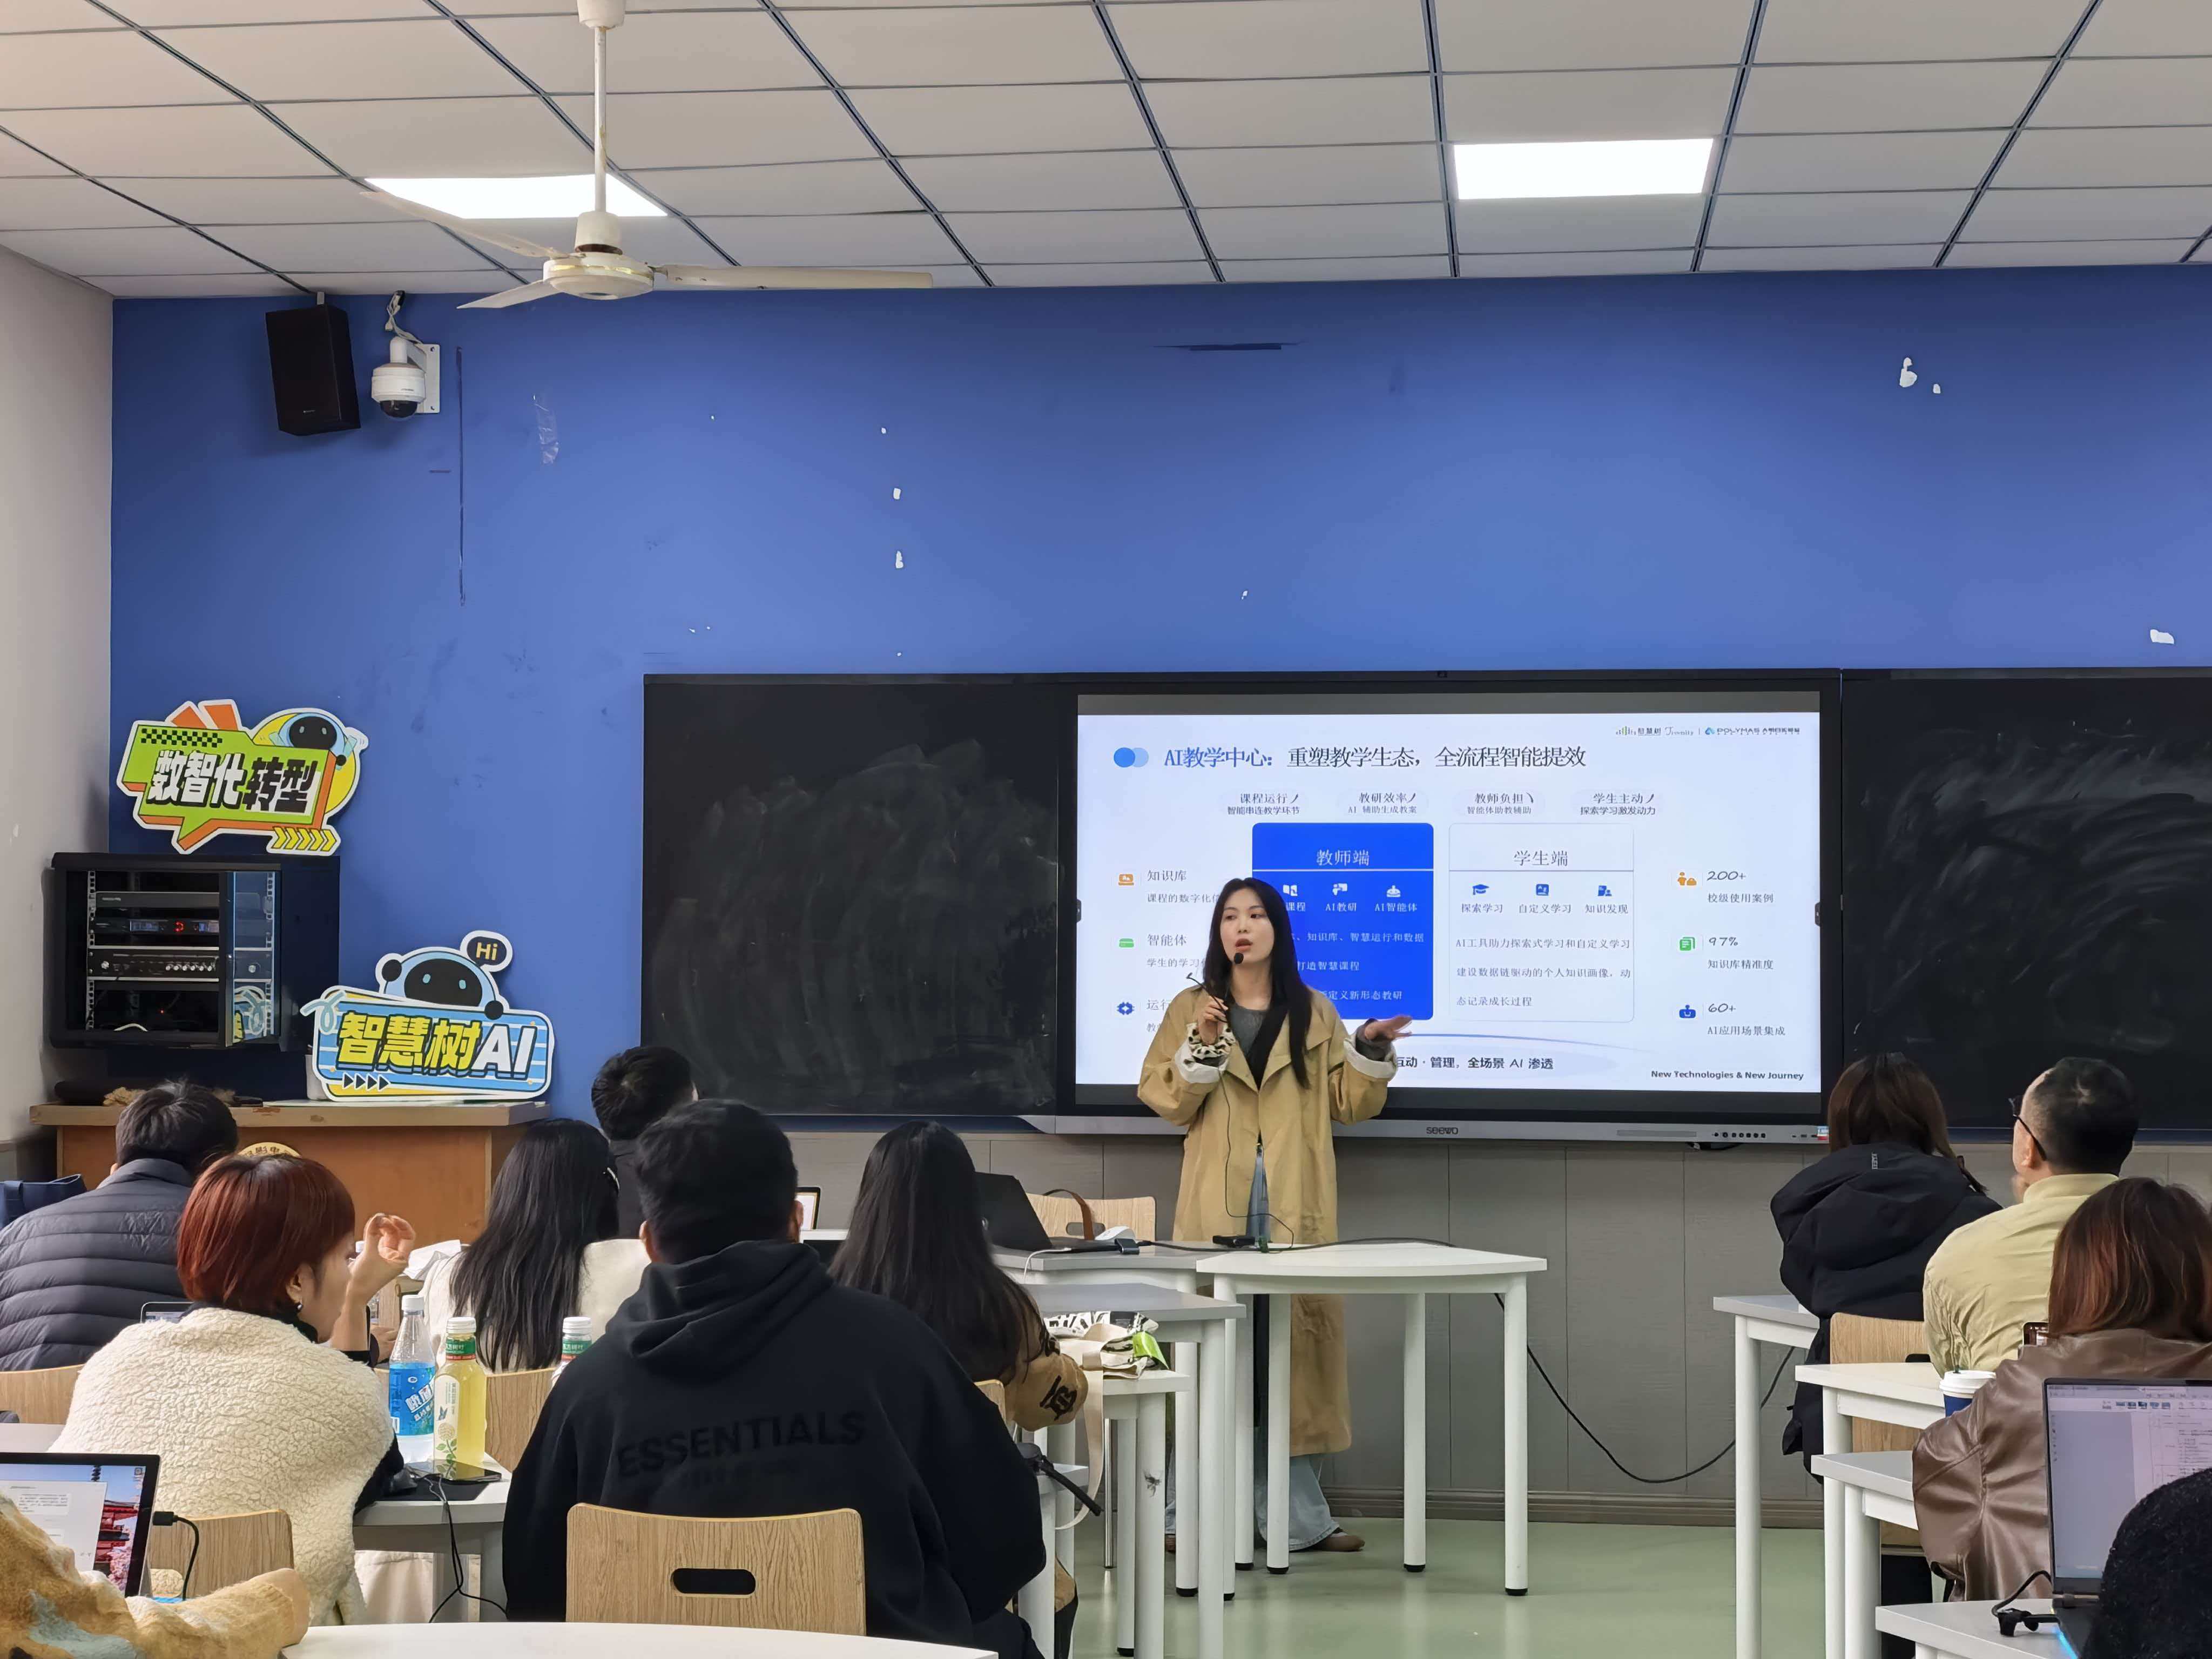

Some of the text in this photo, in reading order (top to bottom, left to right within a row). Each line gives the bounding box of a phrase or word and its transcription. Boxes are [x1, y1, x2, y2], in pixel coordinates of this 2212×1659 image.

[1164, 746, 1586, 768] AI教学中心：重塑教学生态，全流程智能提效
[146, 750, 320, 814] 数智化转型
[1240, 793, 1287, 804] 课程运行
[1358, 792, 1408, 804] 教研效率
[1474, 793, 1523, 804] 教师负担
[1593, 792, 1643, 804] 学生主动
[1362, 805, 1417, 814] 辅助生成教案
[1580, 806, 1656, 815] 探索学习激发动力
[1317, 849, 1370, 866] 教师端
[1514, 850, 1568, 867] 学生端
[1147, 869, 1186, 882] 知识库
[1707, 871, 1746, 881] 200+
[1708, 893, 1773, 903] 校级使用案例
[1325, 902, 1357, 912] AI教研
[1374, 902, 1418, 912] AI智能体
[1461, 902, 1503, 913] 探索学习
[1519, 903, 1572, 914] 自定义学习
[1585, 903, 1629, 914] 知识发现
[1147, 934, 1186, 947] 智能体
[1291, 932, 1425, 943] 、知识库、智慧运行和数据
[1708, 936, 1738, 946] 97%
[1455, 938, 1630, 949] AI工具助力探索式学习和自定义学习
[475, 941, 498, 961] Hi
[1708, 959, 1773, 970] 知识库精准度
[1456, 996, 1532, 1007] 态记录成长过程
[1708, 1003, 1736, 1013] 60+
[1146, 1023, 1161, 1033] 教
[1707, 1026, 1786, 1036] AI应用场景集成
[336, 1011, 537, 1078] 智慧树AI
[1509, 1058, 1523, 1068] AI
[1528, 1057, 1554, 1070] 渗透
[1674, 1070, 1734, 1080] Technologies
[1768, 1072, 1804, 1081] Journey
[617, 1410, 866, 1478] ESSENTIALS
